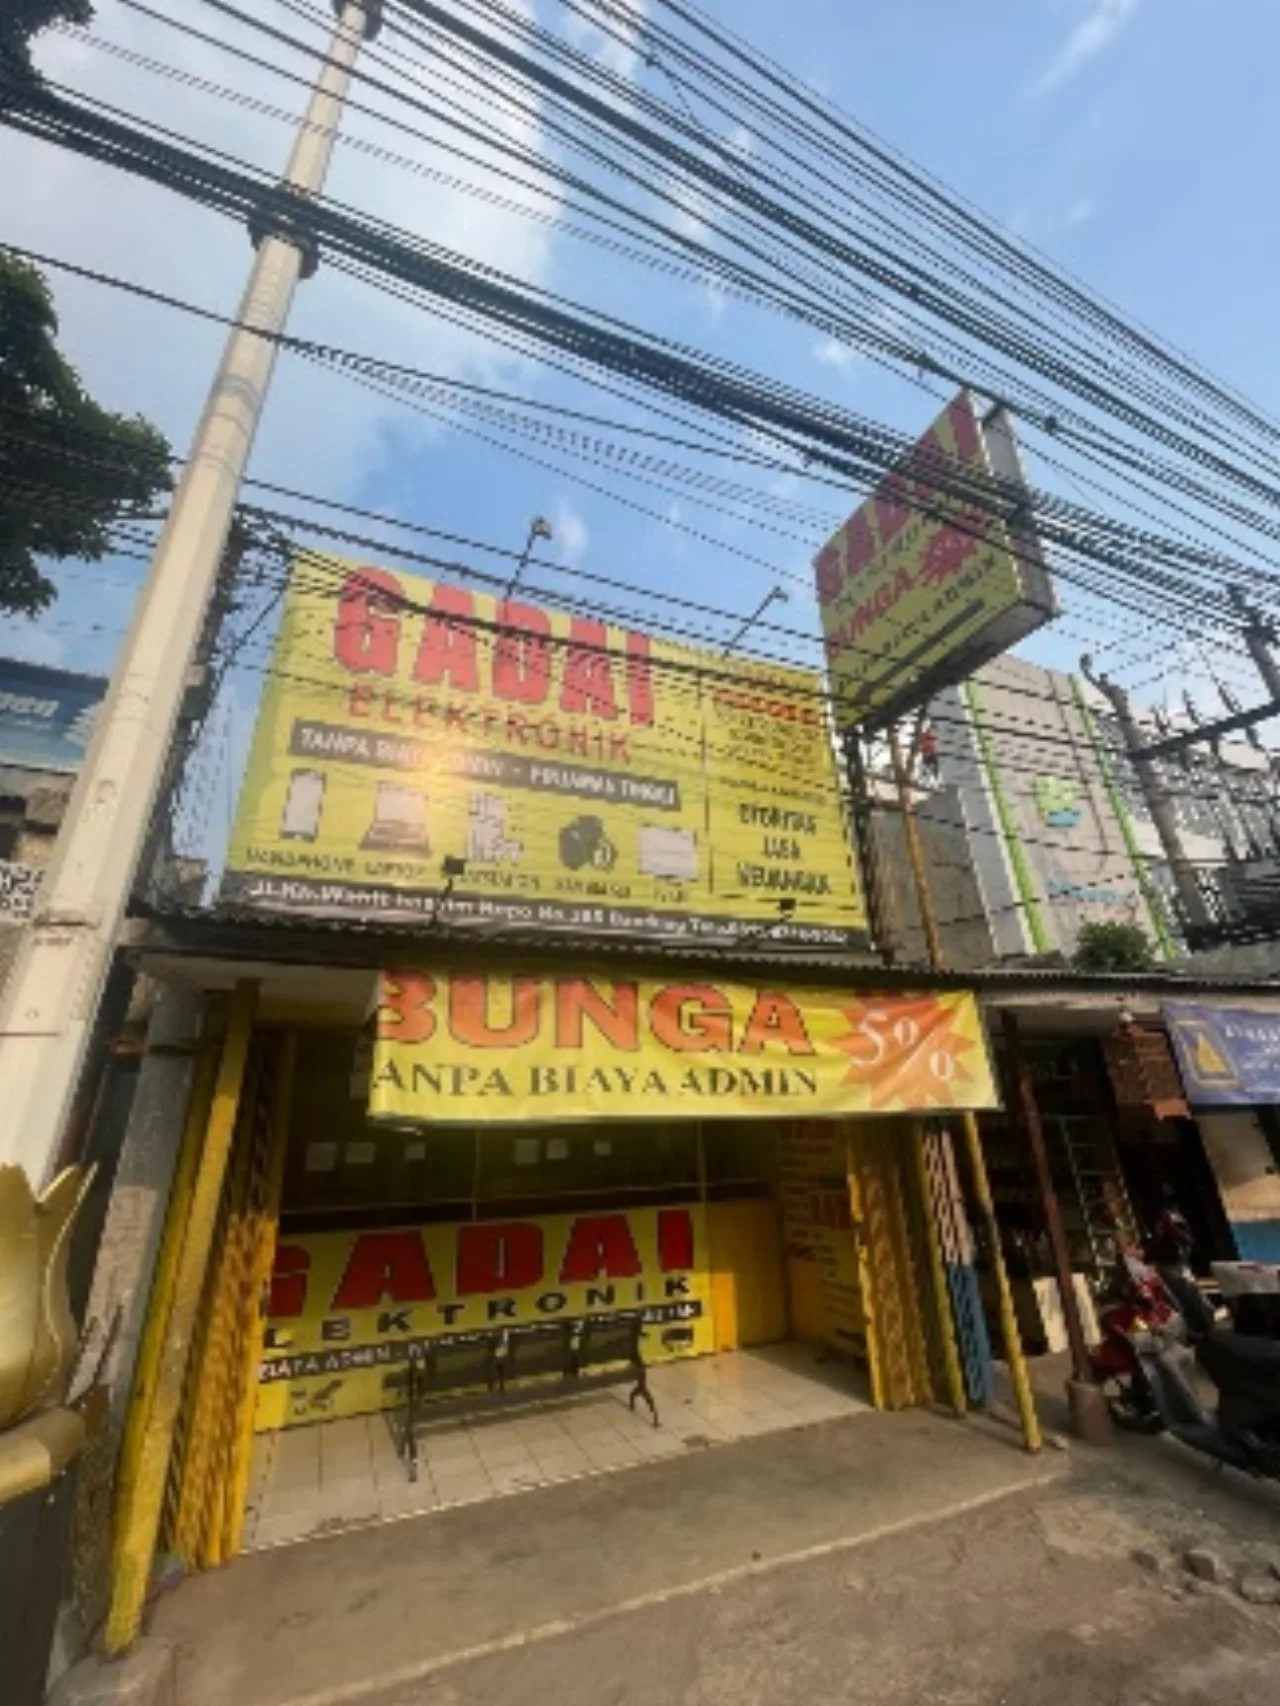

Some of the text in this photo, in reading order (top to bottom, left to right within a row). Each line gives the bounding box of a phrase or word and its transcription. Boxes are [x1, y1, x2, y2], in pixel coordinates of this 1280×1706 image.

[333, 565, 654, 727] GADAI
[381, 967, 955, 1081] BUNGA 5%
[372, 1057, 818, 1096] ANPA BIAYA ADMIN
[264, 1276, 690, 1349] LEKTRONIK
